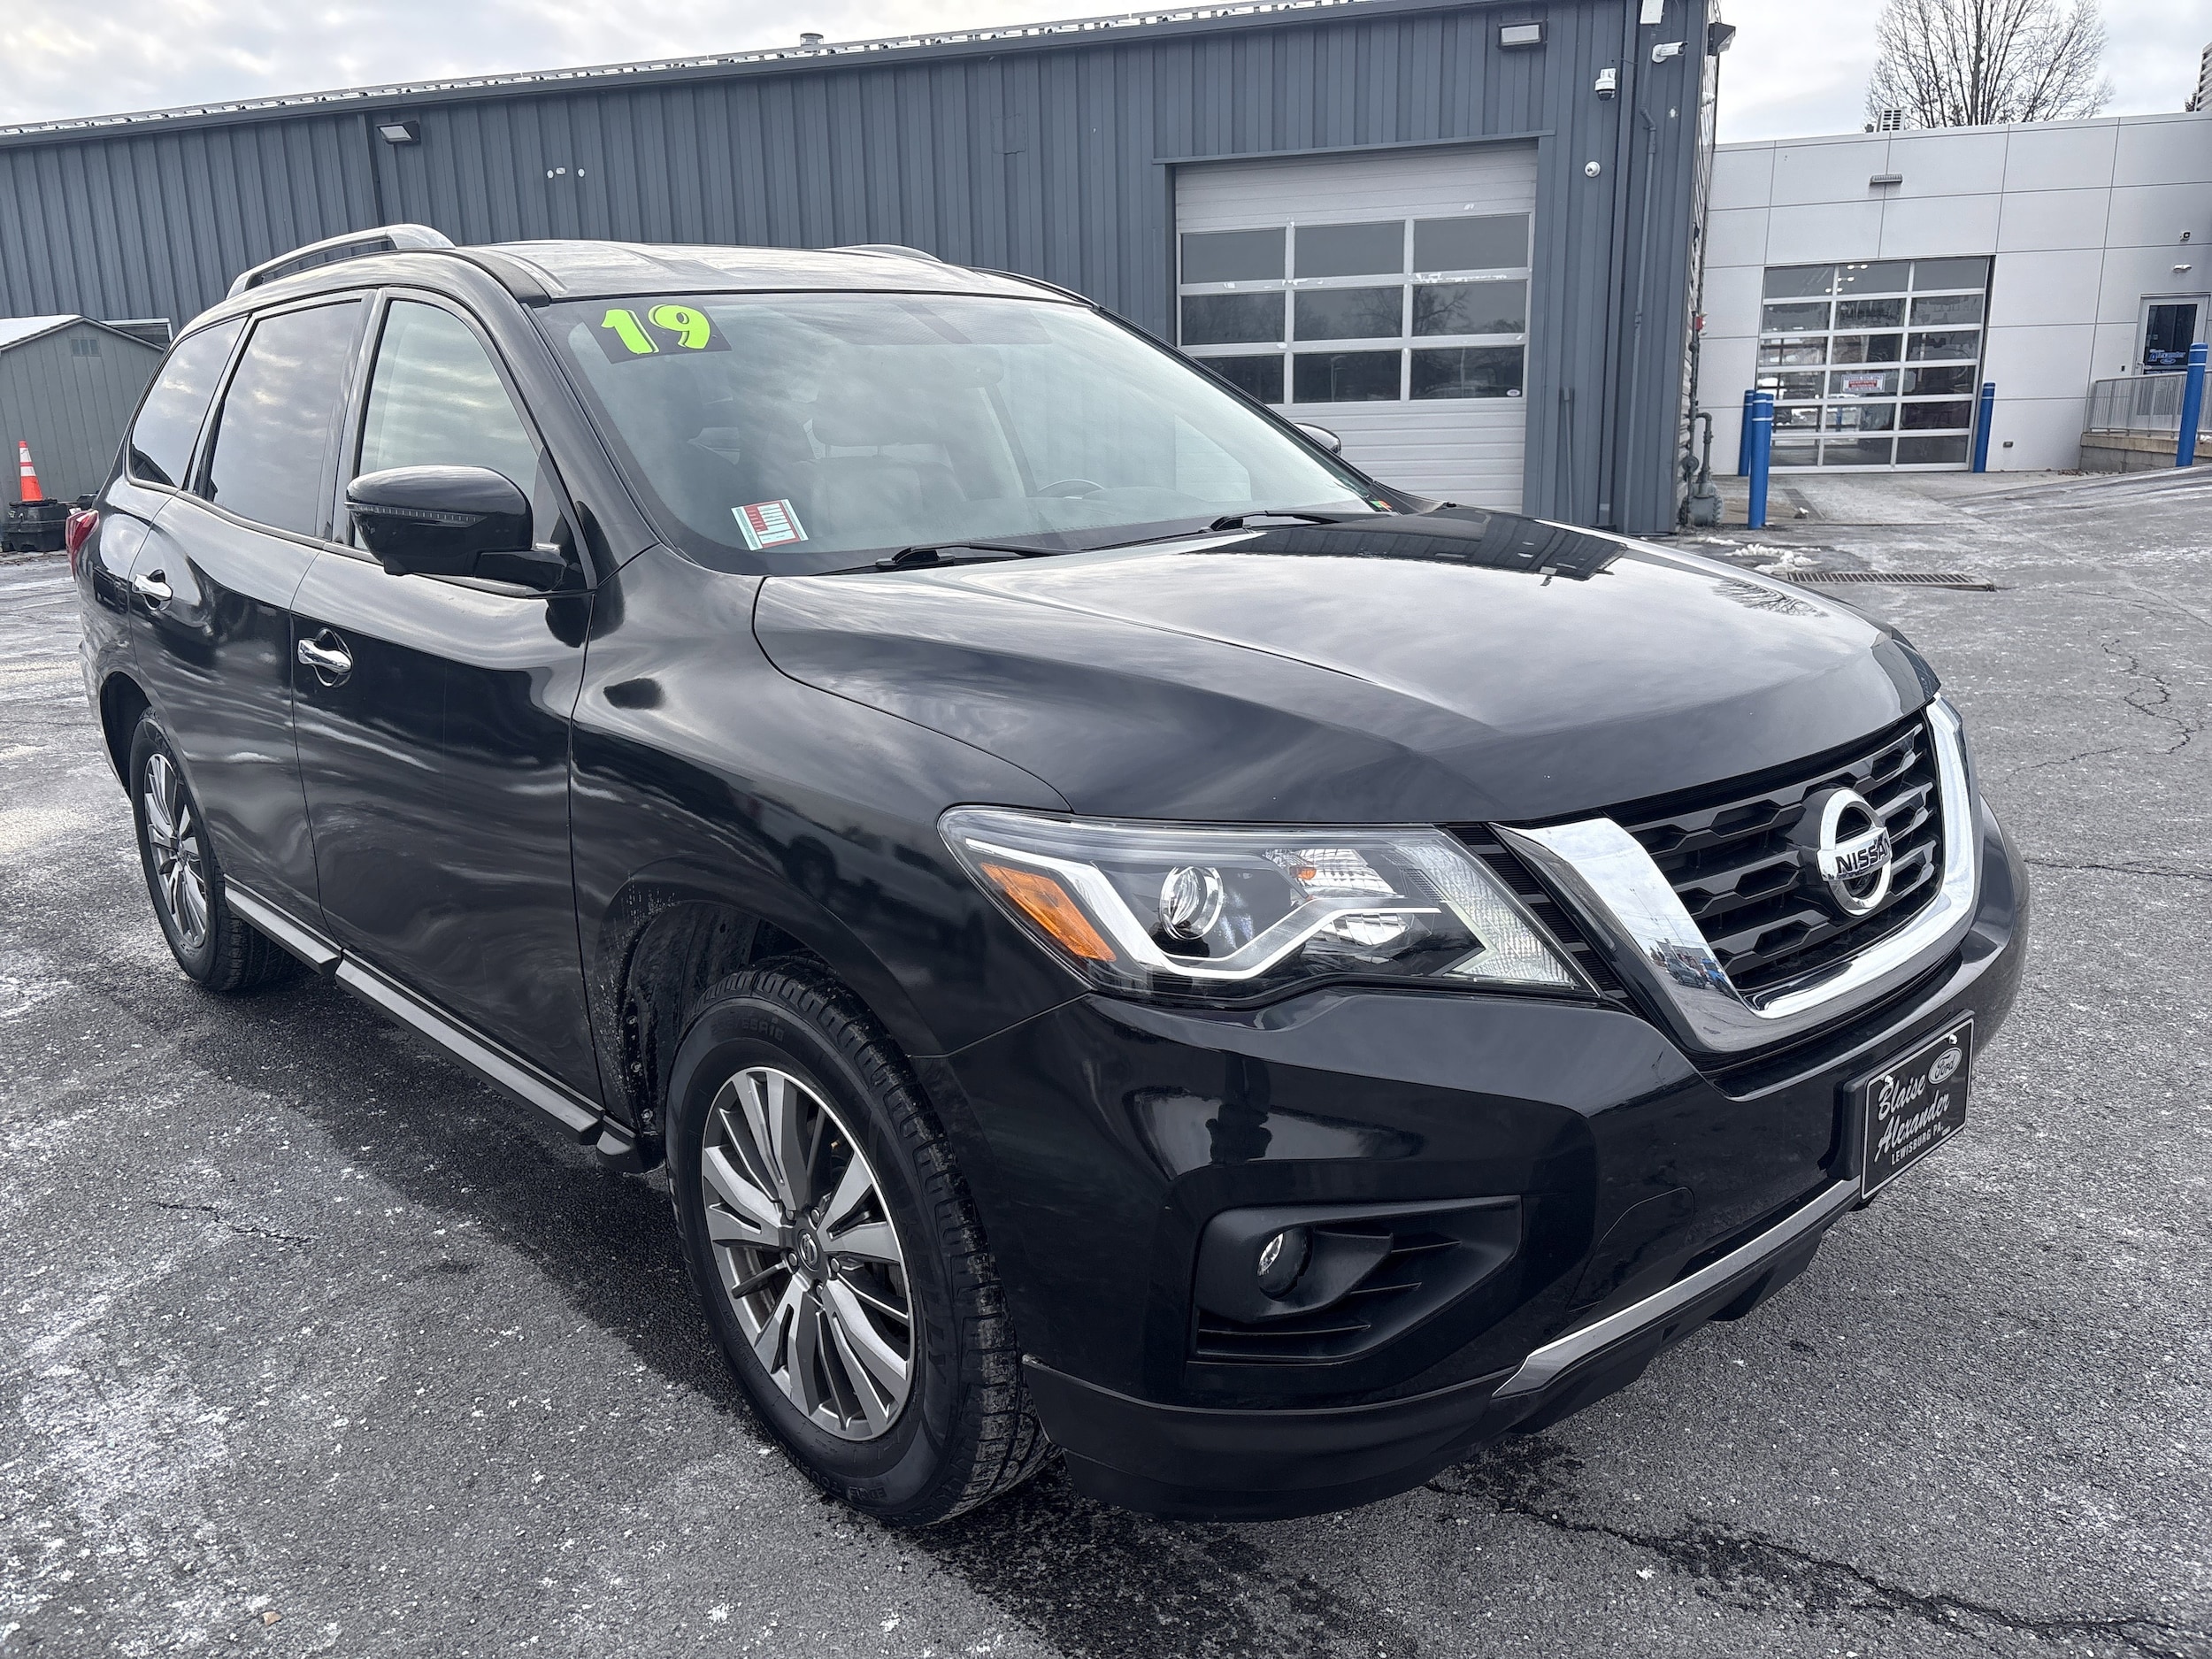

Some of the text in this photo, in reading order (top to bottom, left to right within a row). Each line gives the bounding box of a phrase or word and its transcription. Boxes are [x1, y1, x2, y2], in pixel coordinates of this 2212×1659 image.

[600, 303, 711, 356] 19
[1835, 838, 1892, 874] NISSAN
[1933, 1054, 1955, 1081] Ford
[1878, 1074, 1926, 1121] Blaise
[1874, 1089, 1950, 1163] Alexander
[1891, 1130, 1932, 1166] LEWISBURG
